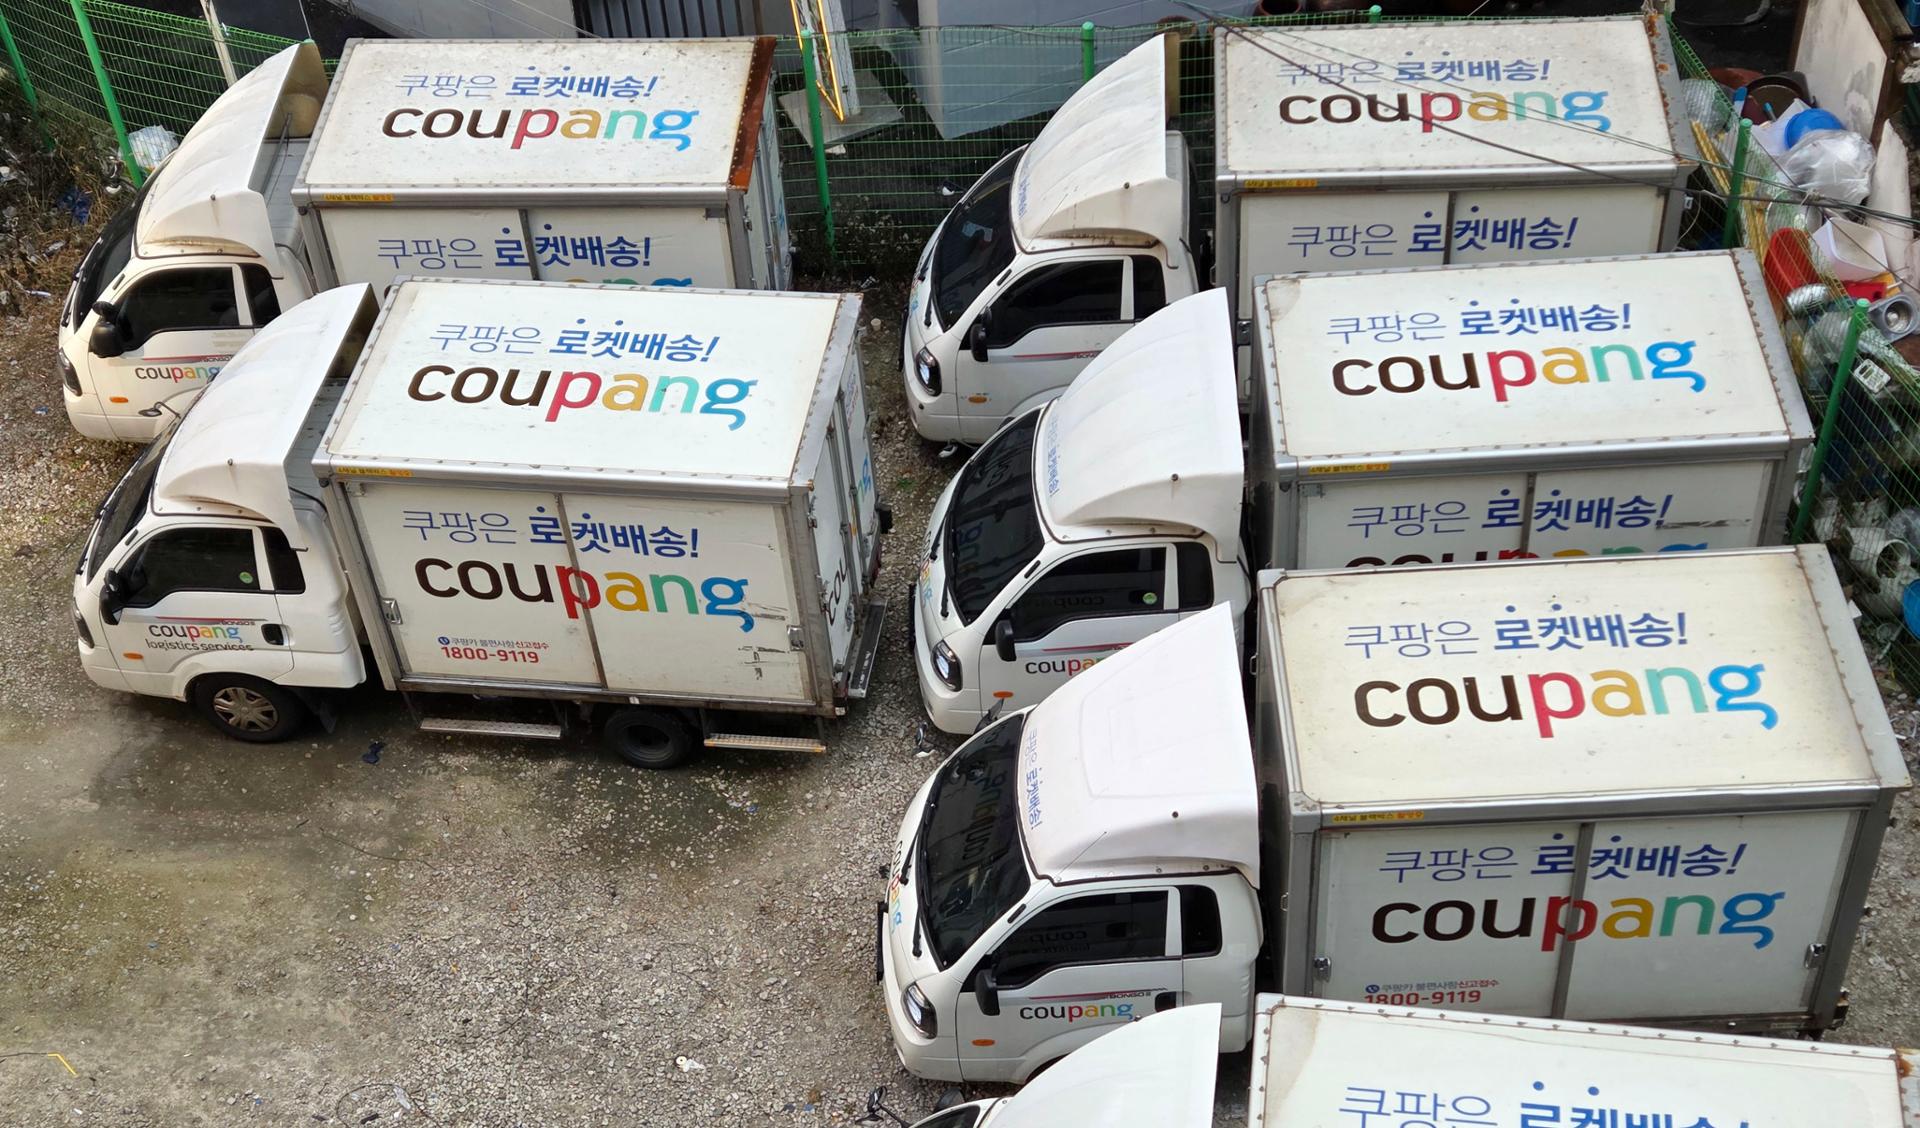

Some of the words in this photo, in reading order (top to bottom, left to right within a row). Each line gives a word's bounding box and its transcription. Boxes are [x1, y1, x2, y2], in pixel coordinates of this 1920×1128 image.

[396, 74, 498, 97] 쿠팡은
[505, 65, 658, 100] 로켓배송!
[1276, 60, 1384, 85] 쿠팡은
[1394, 50, 1550, 83] 로켓배송!
[381, 107, 699, 151] coupang
[1278, 90, 1611, 133] coupang
[377, 238, 483, 269] 쿠팡은
[494, 223, 651, 268] 로켓배송!
[1287, 223, 1397, 259] 쿠팡은
[1407, 206, 1579, 252] 로켓배송!
[429, 322, 543, 355] 쿠팡은
[548, 318, 720, 364] 로켓배송!
[1326, 311, 1447, 344] 쿠팡은
[1458, 297, 1632, 336] 로켓배송!
[1331, 339, 1707, 402] coupang
[407, 364, 758, 431] coupang
[402, 508, 516, 544] 쿠팡은
[529, 506, 699, 559] 로켓배송!
[1346, 500, 1471, 538] 쿠팡은
[1481, 488, 1673, 531] 로켓배송!
[414, 557, 755, 633] coupang
[145, 638, 200, 652] logistics
[200, 642, 254, 651] services
[148, 624, 243, 643] coupang
[1344, 620, 1480, 658] 쿠팡은
[1493, 604, 1689, 651] 로켓배송!
[441, 646, 540, 663] 1800-9119
[1025, 657, 1102, 676] coupa
[1353, 663, 1779, 738] coupang
[1026, 767, 1043, 830] 로켓배송!
[1379, 846, 1518, 883] 쿠팡은
[1531, 833, 1747, 879] 로켓배송!
[889, 840, 903, 934] coupang
[1371, 891, 1786, 952] coupang
[1020, 1003, 1134, 1023] coupang
[1364, 990, 1481, 1006] 1800-9119
[1339, 1086, 1499, 1128] 쿠팡은
